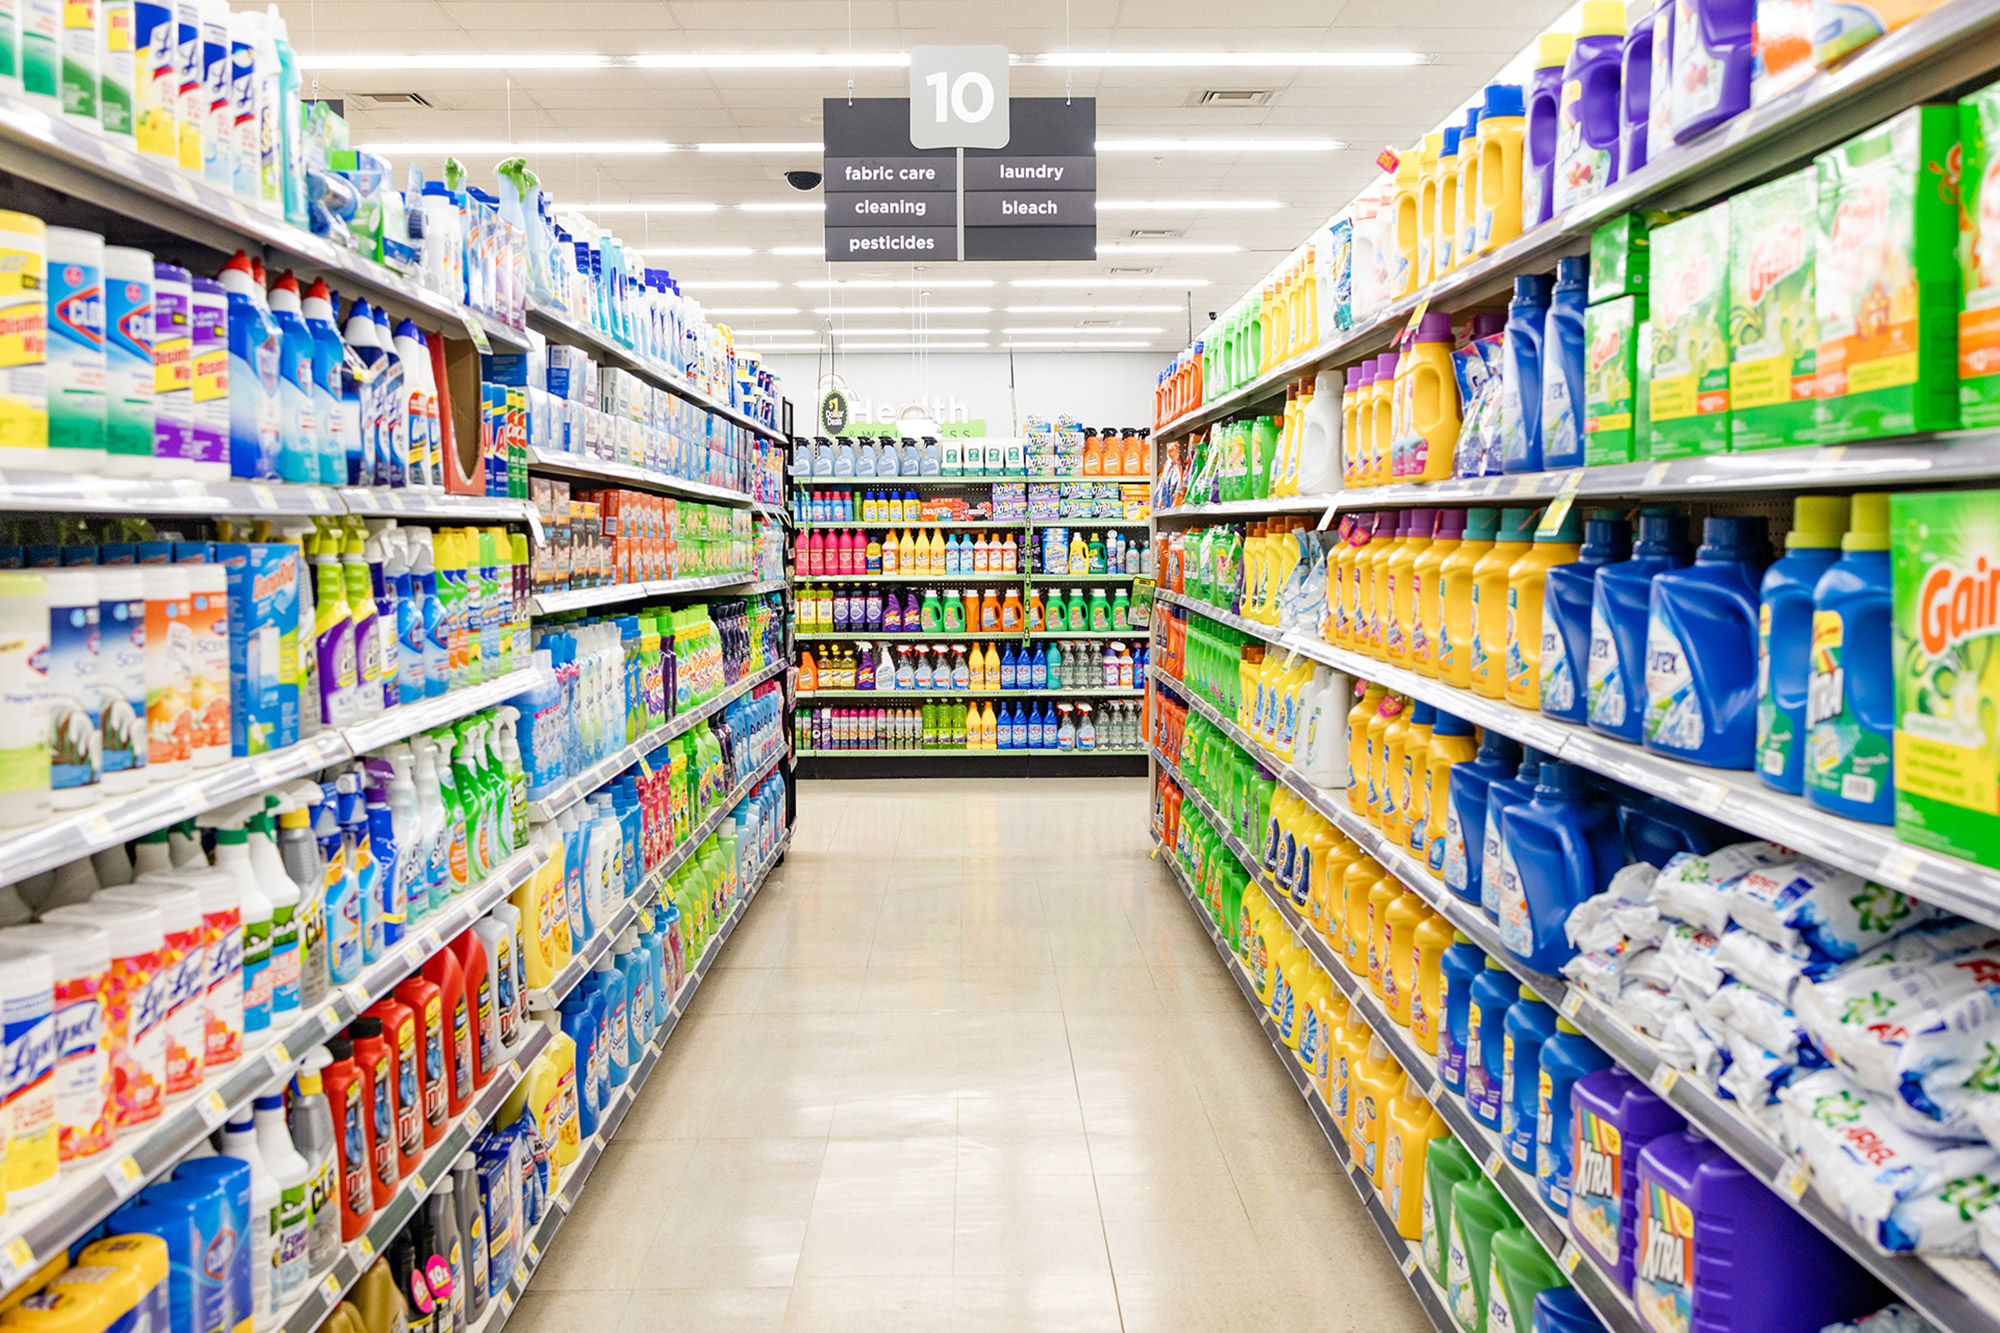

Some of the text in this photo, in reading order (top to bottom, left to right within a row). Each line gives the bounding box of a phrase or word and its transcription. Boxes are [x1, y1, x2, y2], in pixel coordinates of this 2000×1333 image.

[926, 71, 995, 123] 10
[845, 166, 936, 181] fabric care
[1000, 164, 1064, 182] laundry
[855, 200, 926, 216] cleaning
[1002, 200, 1057, 215] bleach
[849, 235, 935, 252] pesticides
[1749, 225, 1803, 303] Gain
[1592, 331, 1619, 371] Gain
[829, 397, 839, 418] $1
[853, 396, 969, 425] Helth
[827, 418, 843, 426] Deals
[922, 506, 948, 516] bounce
[1837, 1126, 1896, 1166] ARIEL
[1575, 1139, 1613, 1200] XTRA
[1641, 1217, 1685, 1288] XTRA
